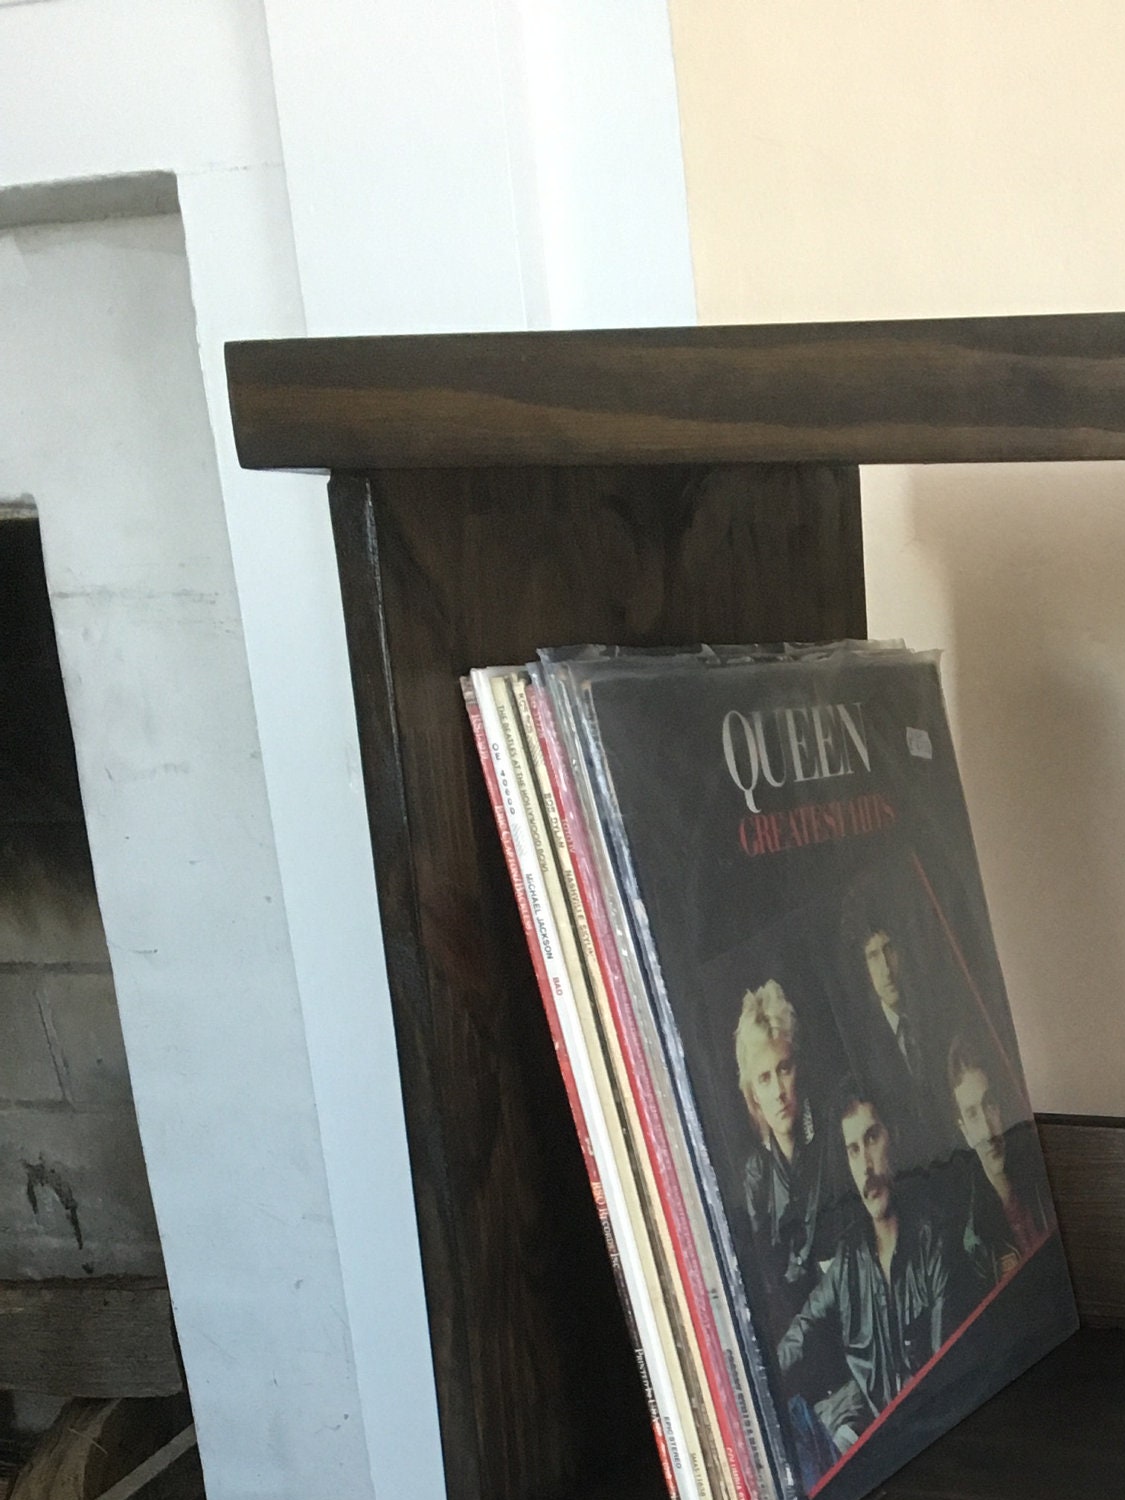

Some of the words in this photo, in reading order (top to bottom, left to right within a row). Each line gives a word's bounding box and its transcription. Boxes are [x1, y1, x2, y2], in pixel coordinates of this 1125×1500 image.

[497, 704, 507, 721] THE
[491, 742, 502, 761] OE
[502, 721, 517, 757] BEATLES
[512, 758, 521, 771] AT
[722, 702, 870, 813] QUEEN
[516, 772, 526, 788] THE
[493, 804, 508, 830] ERIC
[520, 789, 542, 848] HOLLYWOOD
[543, 792, 555, 814] BOB
[550, 817, 564, 849] DYLAN
[739, 801, 846, 857] GREATEST
[849, 793, 896, 835] HITS
[561, 818, 573, 841] TOTO
[567, 841, 576, 853] IV
[564, 869, 584, 920] NASHVILLE
[525, 872, 541, 914] MICHAEL
[536, 916, 553, 960] JACKSON
[552, 976, 563, 996] BAD
[590, 1180, 605, 1205] RSO
[663, 1415, 673, 1435] EPIC
[668, 1436, 682, 1469] STEREO
[726, 1446, 742, 1490] COLUMBIA
